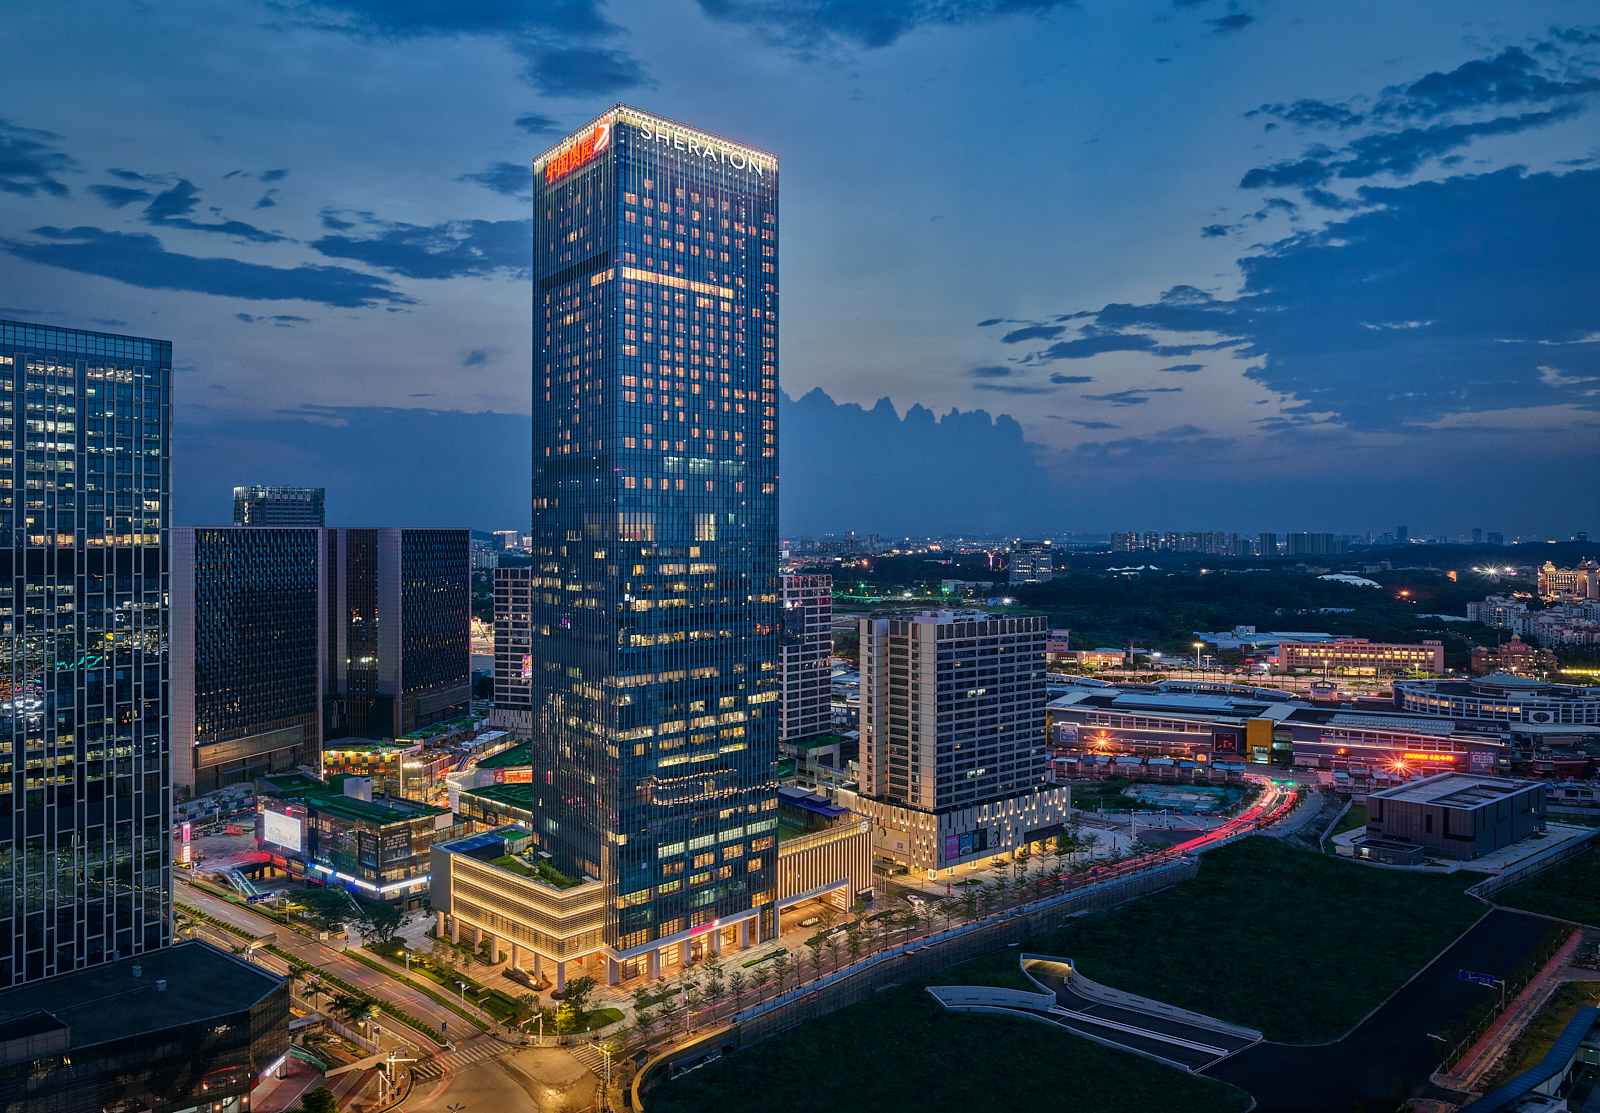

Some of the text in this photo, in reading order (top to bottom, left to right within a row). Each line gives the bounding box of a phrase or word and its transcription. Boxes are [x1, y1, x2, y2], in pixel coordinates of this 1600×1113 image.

[546, 135, 593, 184] 中国奥园
[640, 121, 763, 177] SHERATON
